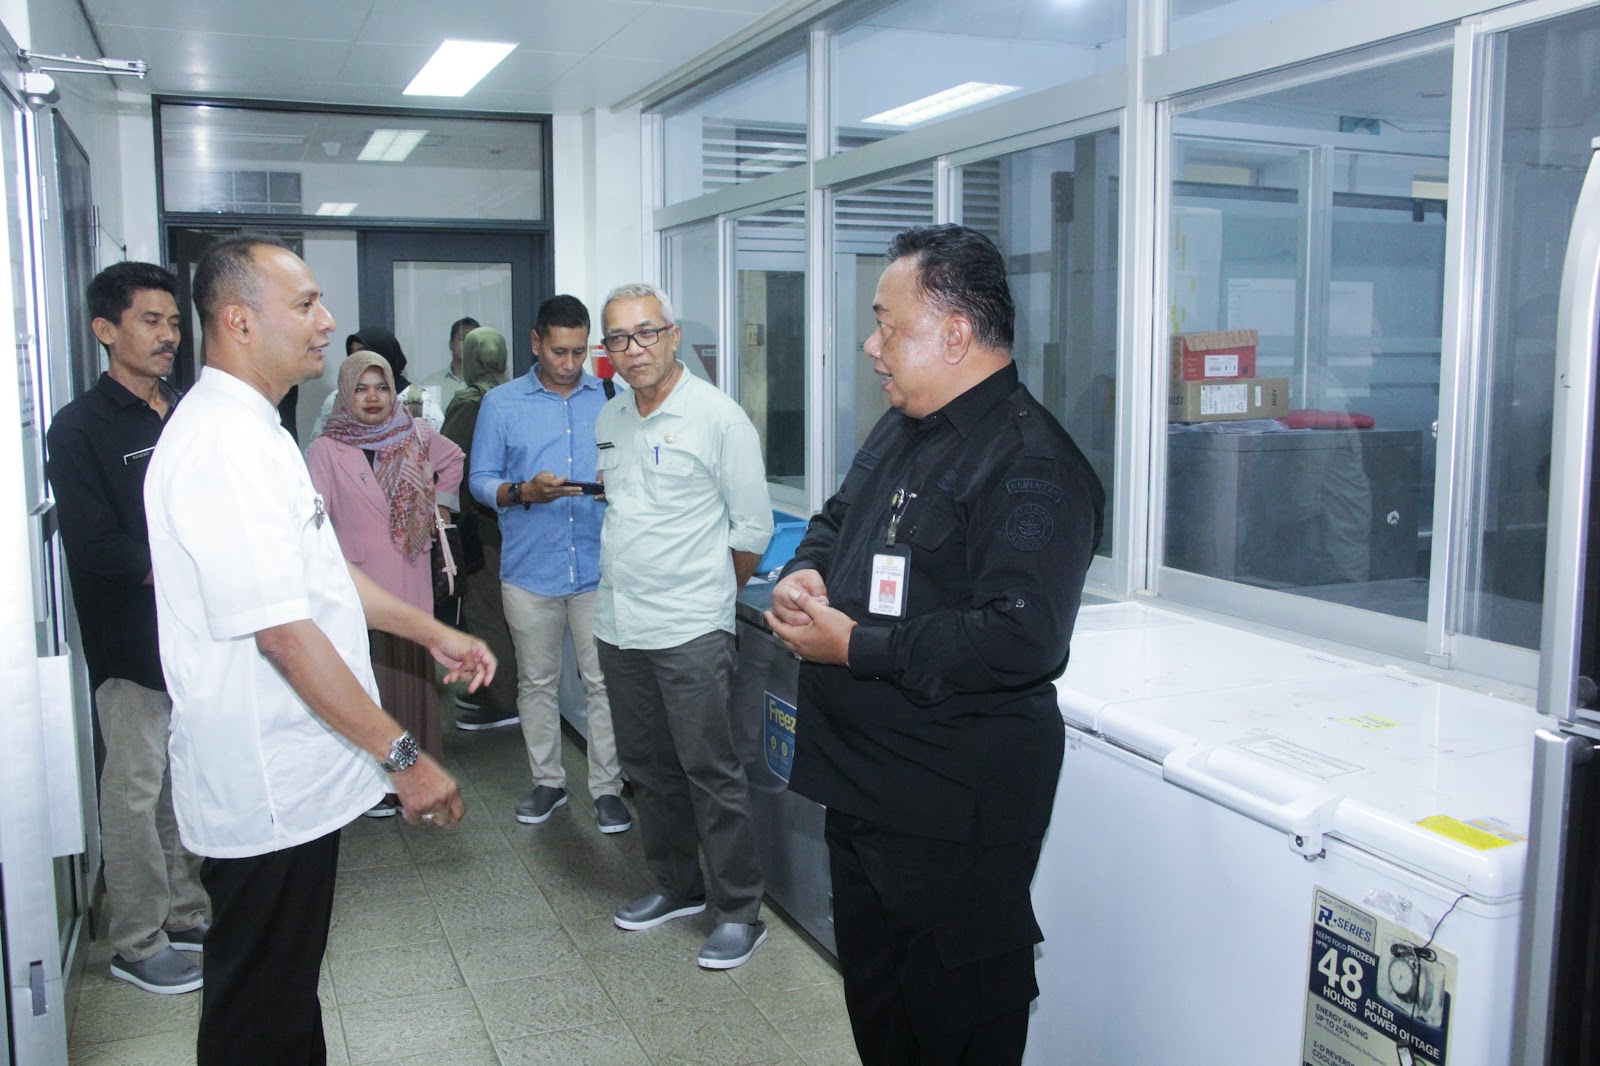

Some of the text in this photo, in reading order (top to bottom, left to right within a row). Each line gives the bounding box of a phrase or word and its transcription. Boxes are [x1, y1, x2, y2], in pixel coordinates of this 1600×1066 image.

[1319, 895, 1372, 925] AQUA CHEST FREEZER
[1315, 930, 1376, 966] KEEPS FOOD FROZEN
[1318, 947, 1364, 1000] 48
[1323, 986, 1358, 1013] HOURS
[1365, 999, 1394, 1021] AFTER
[1315, 1012, 1350, 1038] UP TO 25%
[1316, 1003, 1369, 1040] ENERGY SAVING
[1364, 1009, 1398, 1035] POWER
